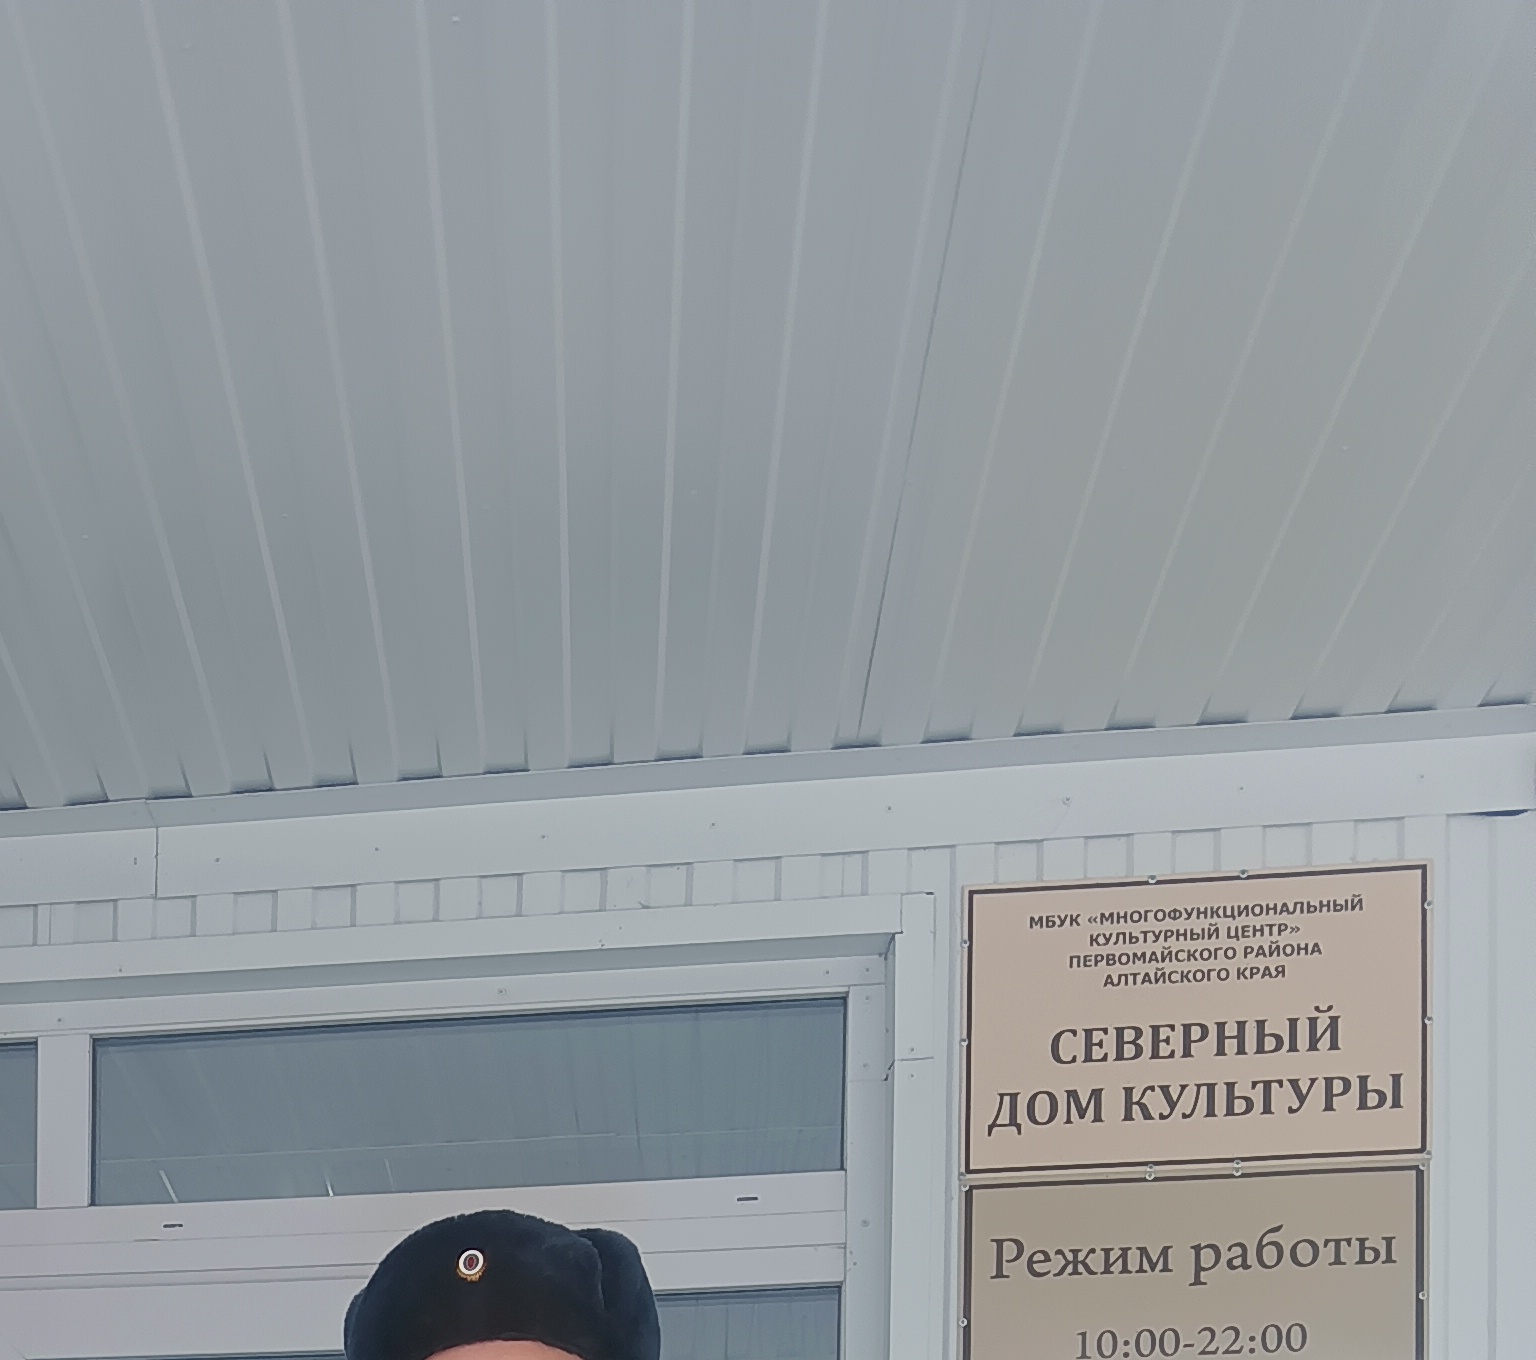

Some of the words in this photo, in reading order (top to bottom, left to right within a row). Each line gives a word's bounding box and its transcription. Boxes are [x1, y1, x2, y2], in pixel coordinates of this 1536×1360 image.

[1028, 912, 1081, 931] МБУК
[1086, 894, 1364, 927] «МНОГОФУНКЦИОНАЛЬНЫЙ
[1068, 941, 1238, 969] ПЕРВОМАЙСКОГО
[1242, 939, 1323, 960] РАЙОНА
[1088, 923, 1221, 948] КУЛЬТУРНЫЙ
[1225, 922, 1301, 943] ЦЕНТР»
[1102, 963, 1231, 988] АЛТАЙСКОГО
[1236, 964, 1287, 981] КРАЯ
[1049, 1004, 1342, 1066] СЕВЕРНЫЙ
[986, 1087, 1106, 1137] ДОМ
[1120, 1072, 1405, 1124] КУЛЬТУРЫ
[989, 1237, 1175, 1280] Режим
[1188, 1223, 1398, 1287] работы
[1074, 1321, 1309, 1360] 10:00-22:00
